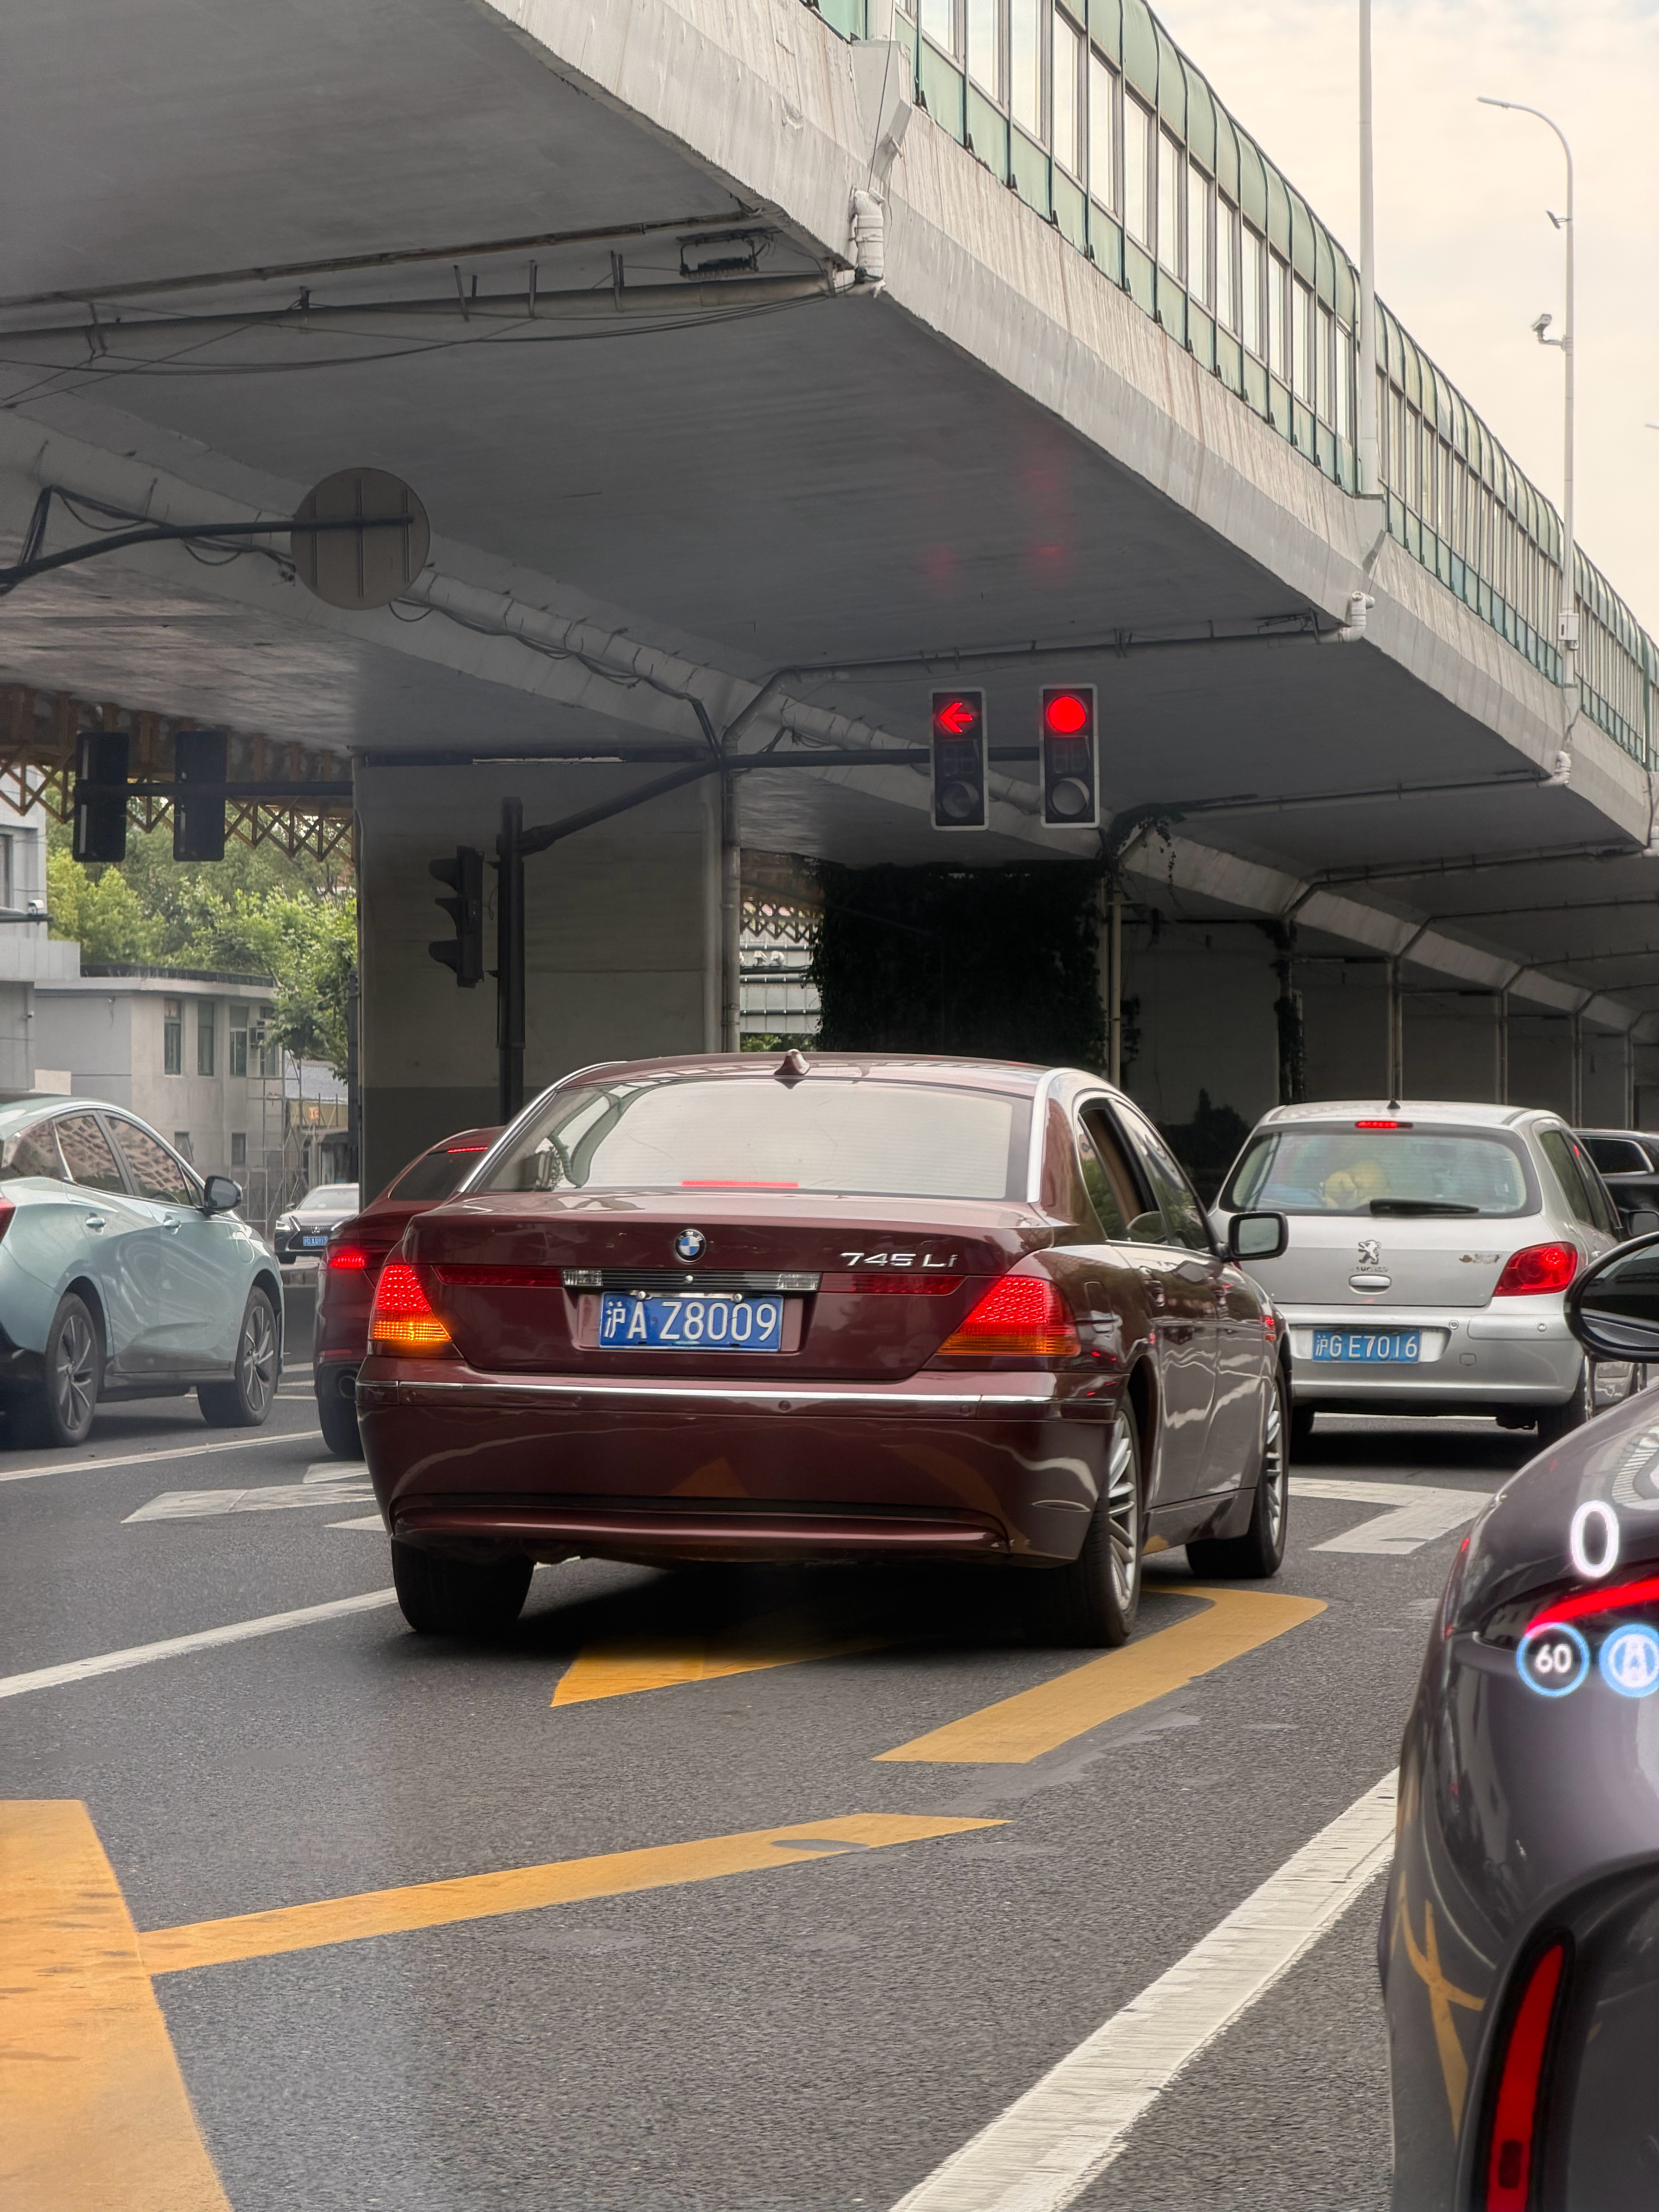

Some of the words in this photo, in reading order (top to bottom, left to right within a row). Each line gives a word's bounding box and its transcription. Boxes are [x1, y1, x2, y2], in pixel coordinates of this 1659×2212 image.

[840, 1252, 917, 1266] 745
[921, 1254, 958, 1267] Li
[659, 1301, 777, 1341] Z8009
[1570, 1500, 1619, 1578] 0
[1535, 1644, 1573, 1674] 60
